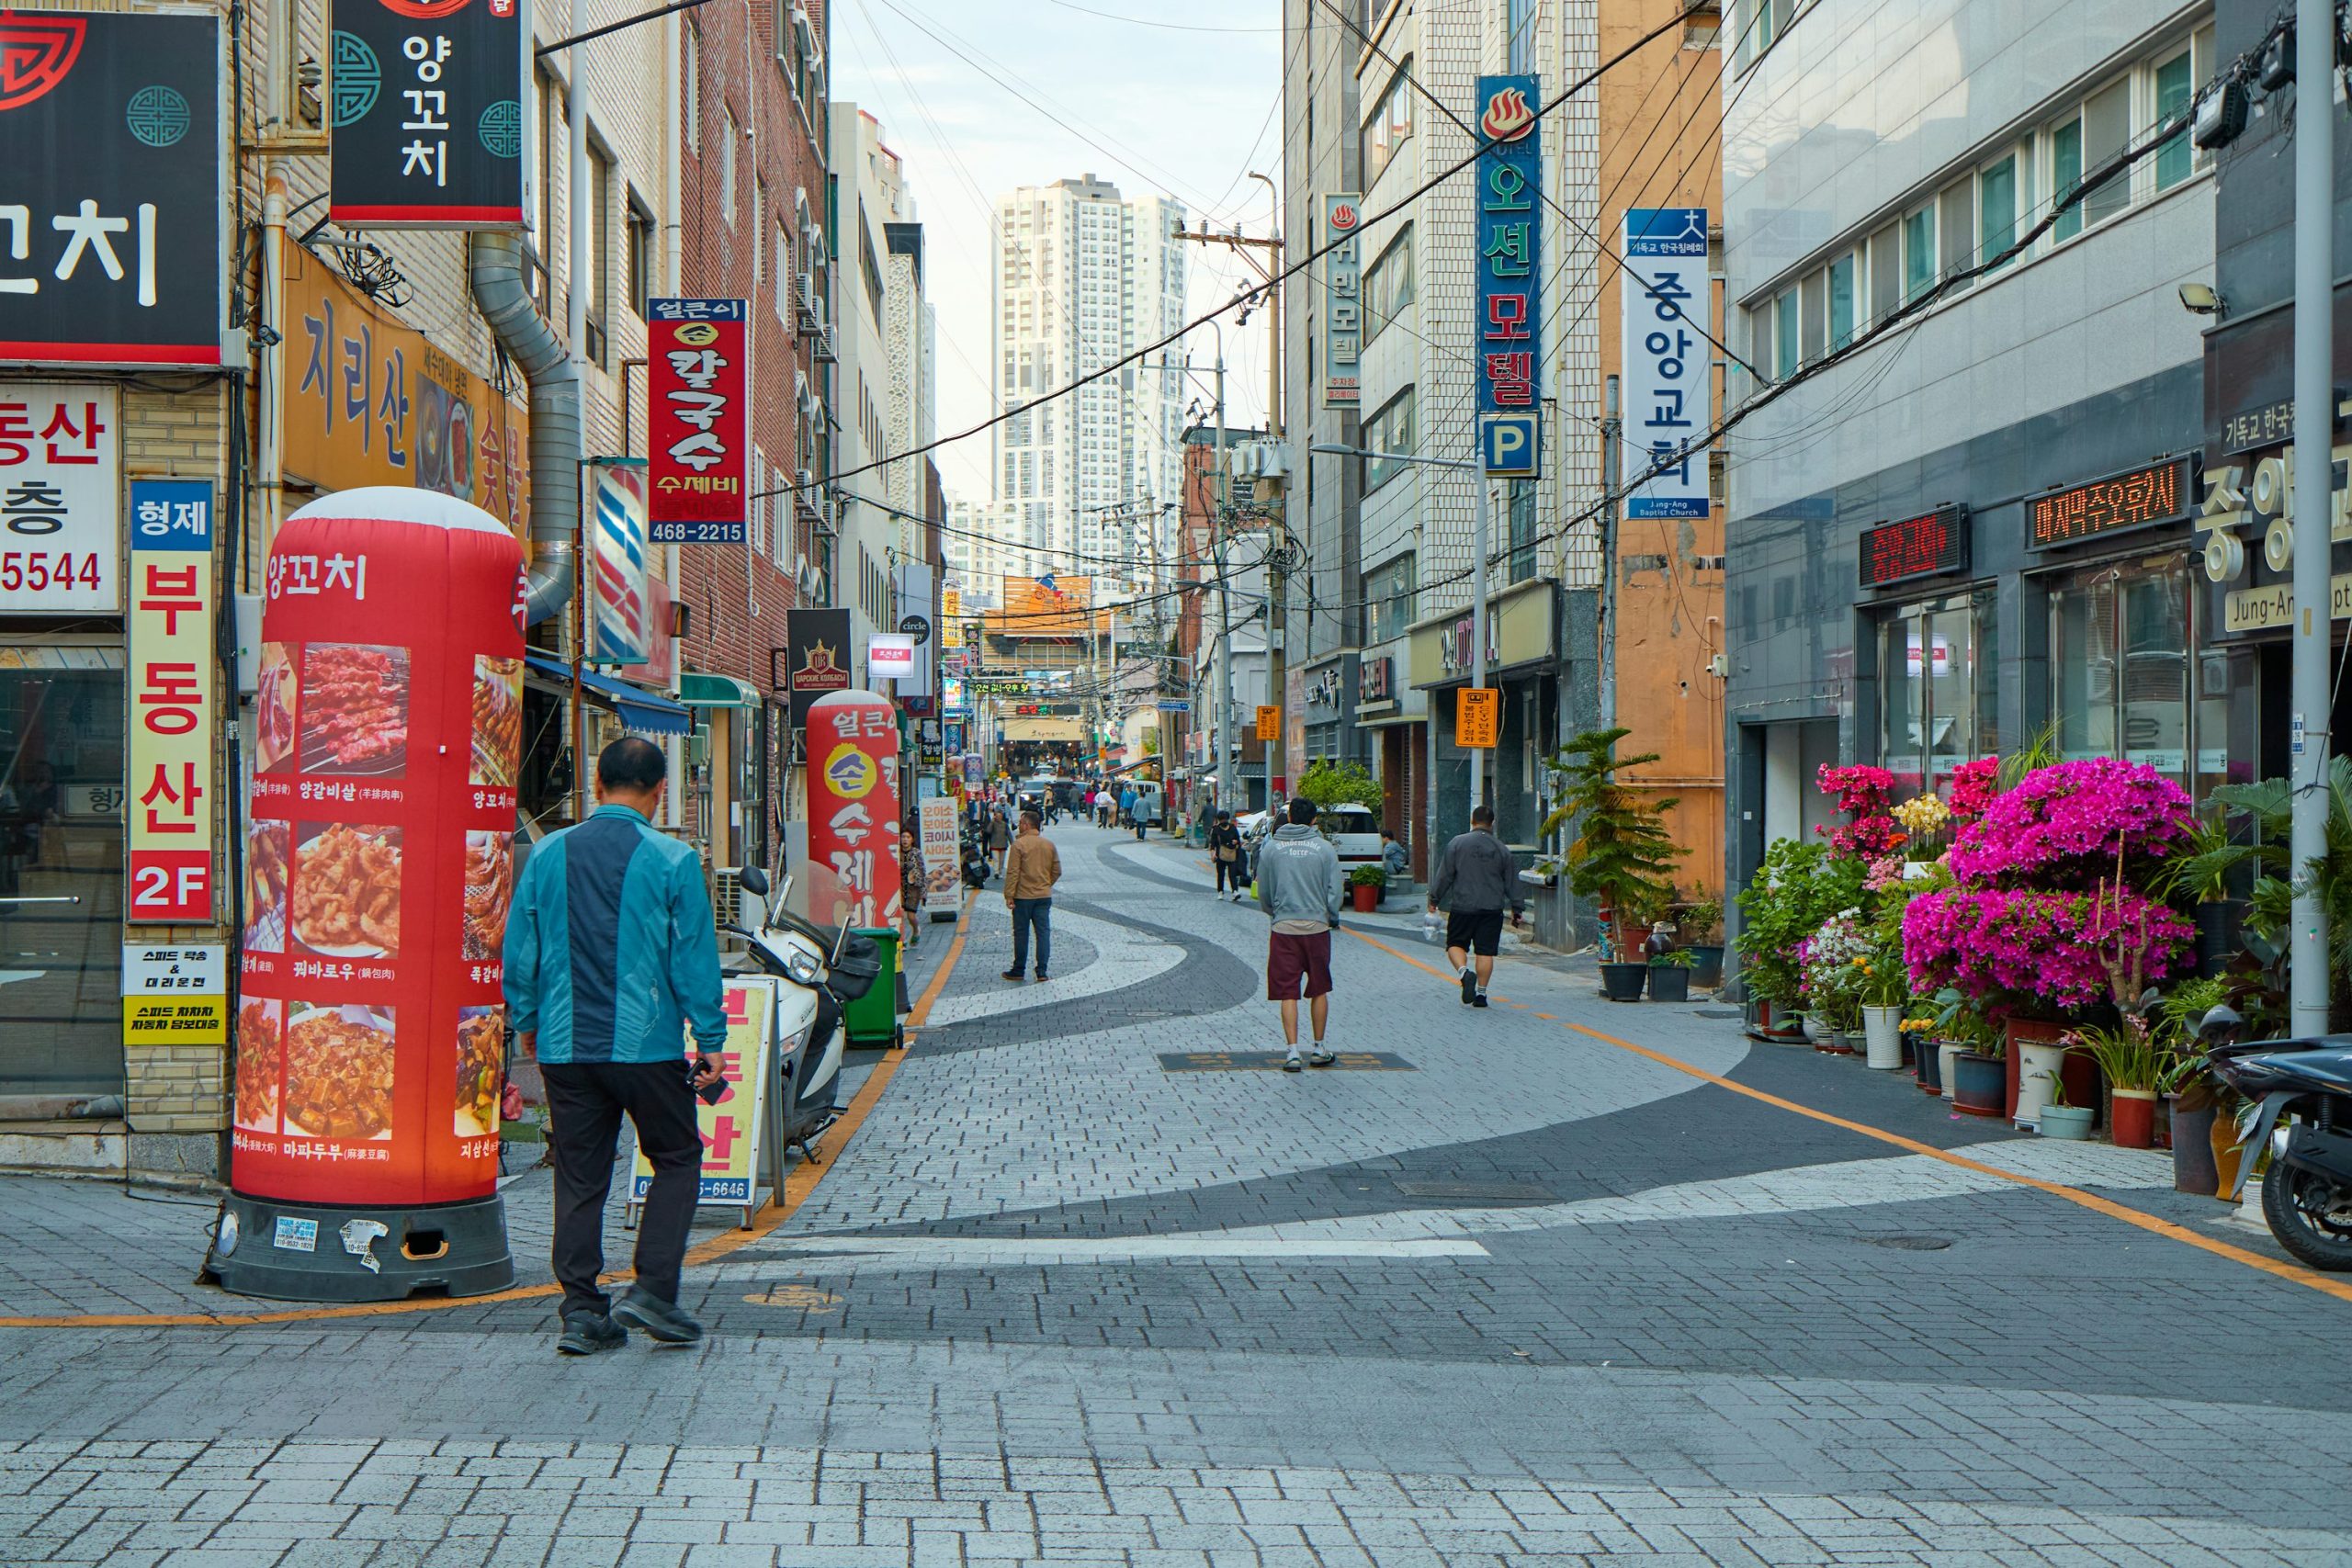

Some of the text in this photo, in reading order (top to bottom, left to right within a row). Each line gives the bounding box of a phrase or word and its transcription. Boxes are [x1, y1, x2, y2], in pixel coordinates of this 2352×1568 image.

[402, 36, 452, 186] 양꼬치
[656, 300, 739, 320] 얼큰이
[300, 298, 409, 468] 지리산
[1331, 378, 1355, 387] 주차장
[1645, 272, 1692, 487] 중앙교회
[666, 348, 729, 472] 칼국수
[2226, 414, 2260, 447] 기독교
[1493, 425, 1525, 466] P
[656, 476, 738, 494] 수제비
[2, 481, 68, 535] 층
[138, 501, 207, 536] 형제
[653, 523, 742, 542] 468-2215
[2, 552, 101, 591] 5544
[268, 553, 367, 600] 양꼬치
[902, 621, 926, 630] circle
[140, 564, 203, 833] 부동산
[300, 781, 356, 801] 양갈비살
[473, 790, 506, 809] 양꼬치
[923, 806, 955, 817] 오이소
[135, 867, 206, 906] 2F
[142, 951, 178, 962] 스피드
[170, 964, 180, 974] &
[293, 960, 356, 980] 꿔바로우
[469, 964, 500, 984] 쪽갈비
[137, 1006, 213, 1017] 스피드 차차차
[131, 1019, 220, 1030] 자동차 담보대출
[283, 1141, 343, 1162] 마파두부
[460, 1138, 490, 1159] 지삼선
